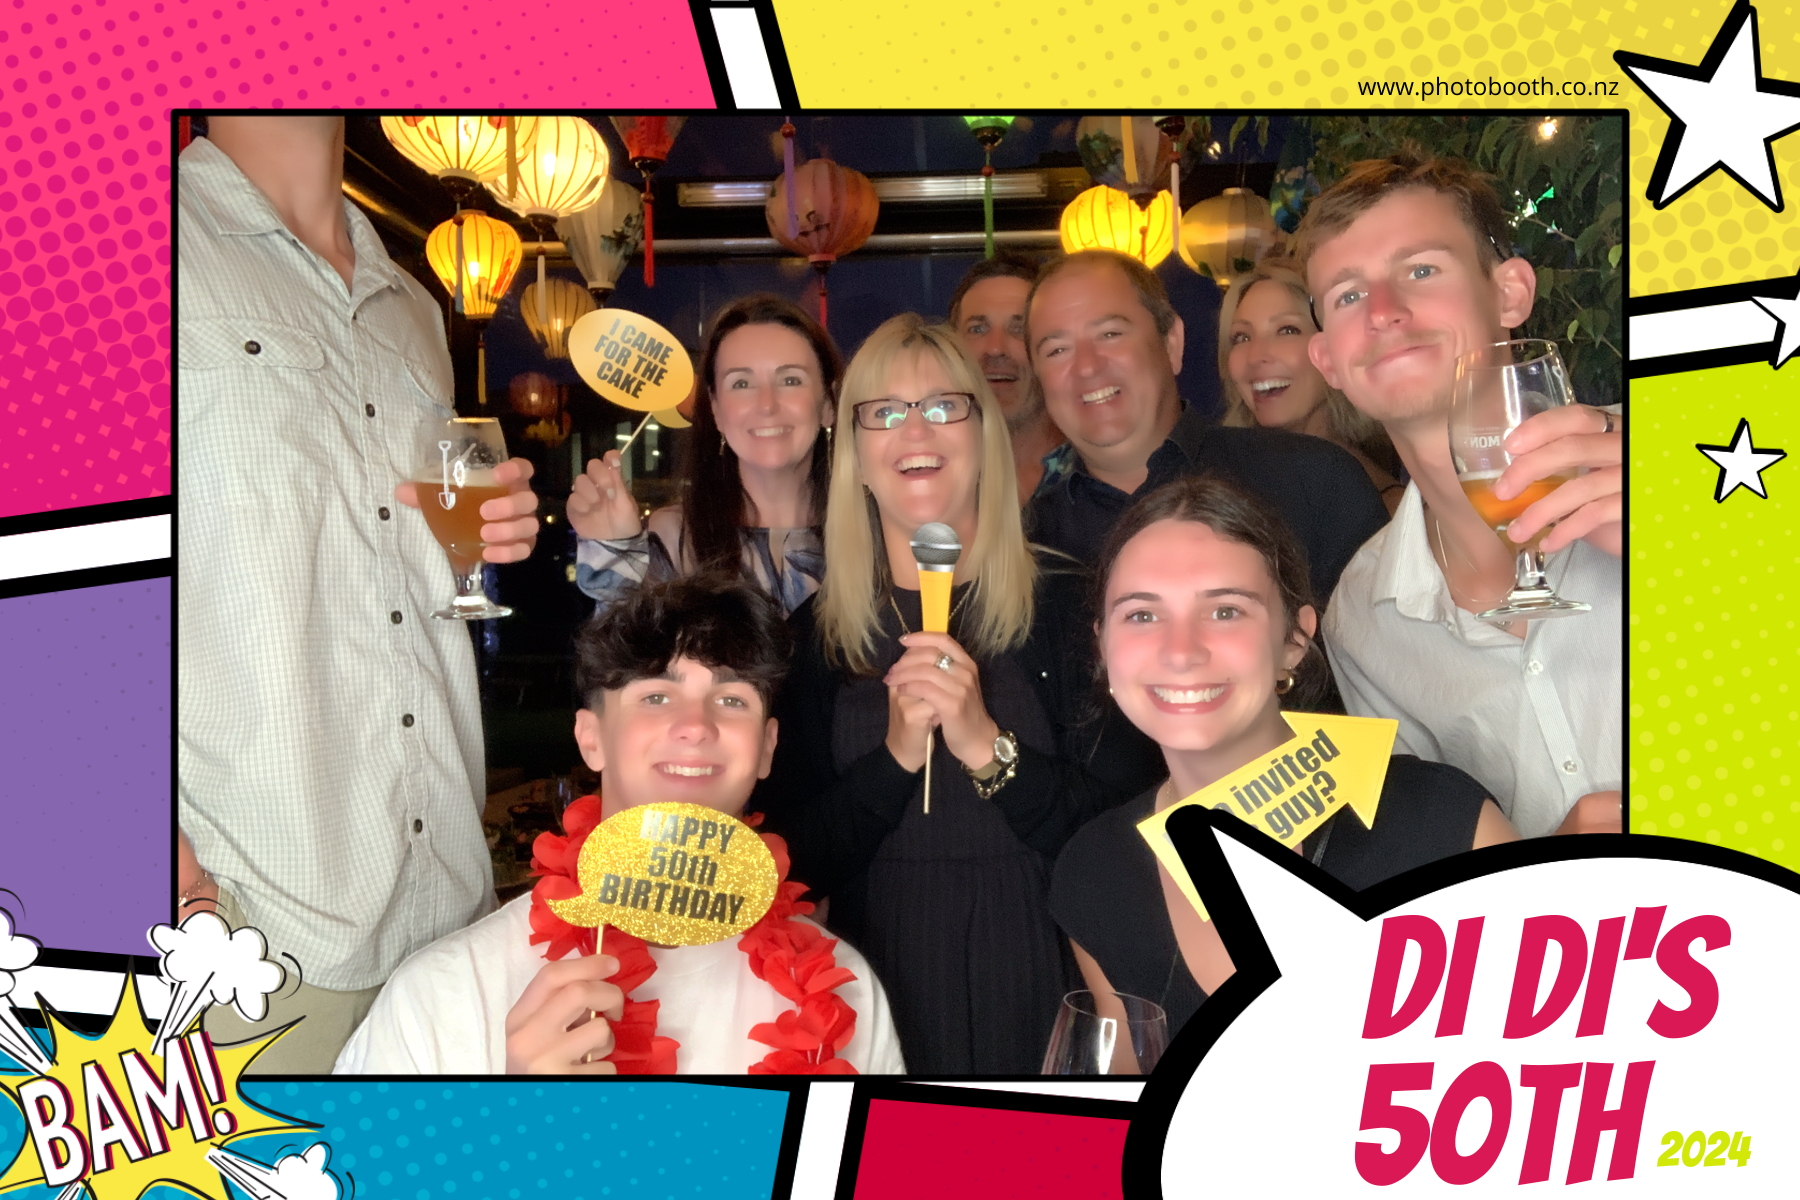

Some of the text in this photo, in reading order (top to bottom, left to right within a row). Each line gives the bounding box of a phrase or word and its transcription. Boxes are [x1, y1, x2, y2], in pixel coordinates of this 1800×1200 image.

[594, 334, 668, 387] FOR THE
[608, 318, 673, 366] I CAME
[596, 361, 646, 399] CAKE
[1229, 728, 1341, 815] invited
[1264, 770, 1337, 840] guy?
[639, 808, 736, 854] HAPPY
[647, 846, 718, 886] 50th
[598, 873, 745, 925] BIRTHDAY
